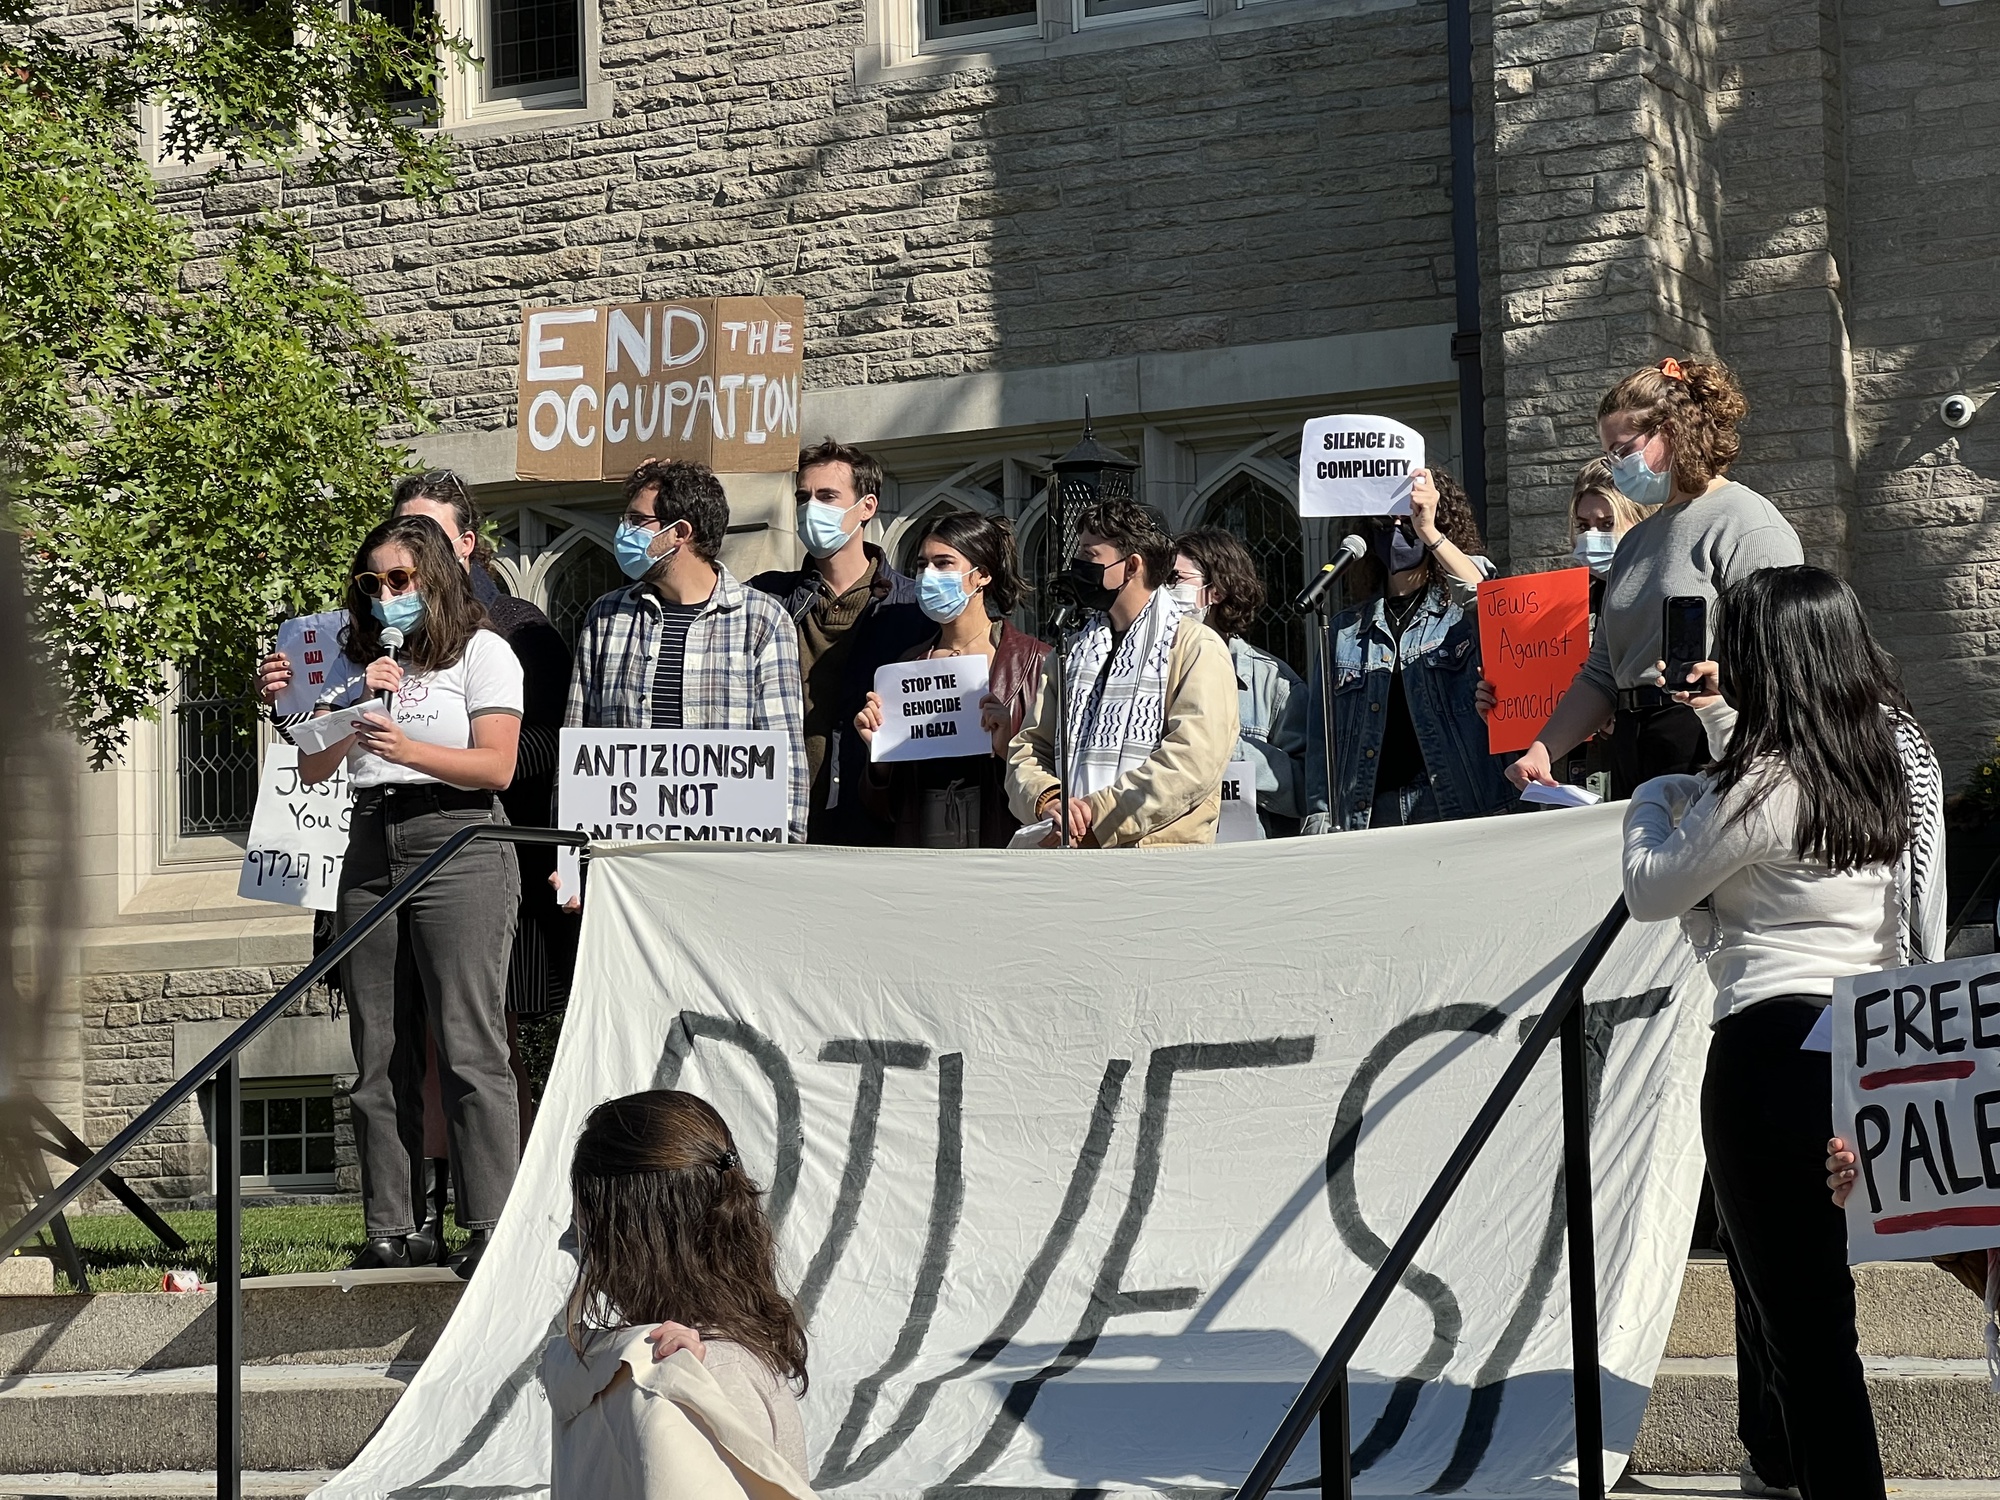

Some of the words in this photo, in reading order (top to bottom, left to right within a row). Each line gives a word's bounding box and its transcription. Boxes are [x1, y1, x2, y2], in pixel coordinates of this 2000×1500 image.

[526, 305, 708, 381] END
[722, 320, 794, 355] THE
[528, 371, 798, 451] OCCUPATION
[1323, 432, 1386, 450] SILENCE
[1388, 433, 1405, 449] IS
[1316, 459, 1411, 479] COMPLICITY
[1483, 587, 1539, 617] Jews
[304, 630, 316, 644] LET
[1499, 627, 1573, 669] Against
[304, 650, 324, 665] GAZA
[308, 671, 324, 685] LIVE
[901, 677, 932, 693] STOP
[933, 674, 957, 690] THE
[902, 697, 962, 717] GENOCIDE
[910, 725, 924, 739] IN
[925, 721, 957, 738] GAZA
[573, 743, 776, 780] ANTIZIONISM
[610, 782, 638, 816] IS
[658, 783, 719, 818] NOT
[288, 802, 332, 831] You
[1854, 971, 2000, 1068] FREE
